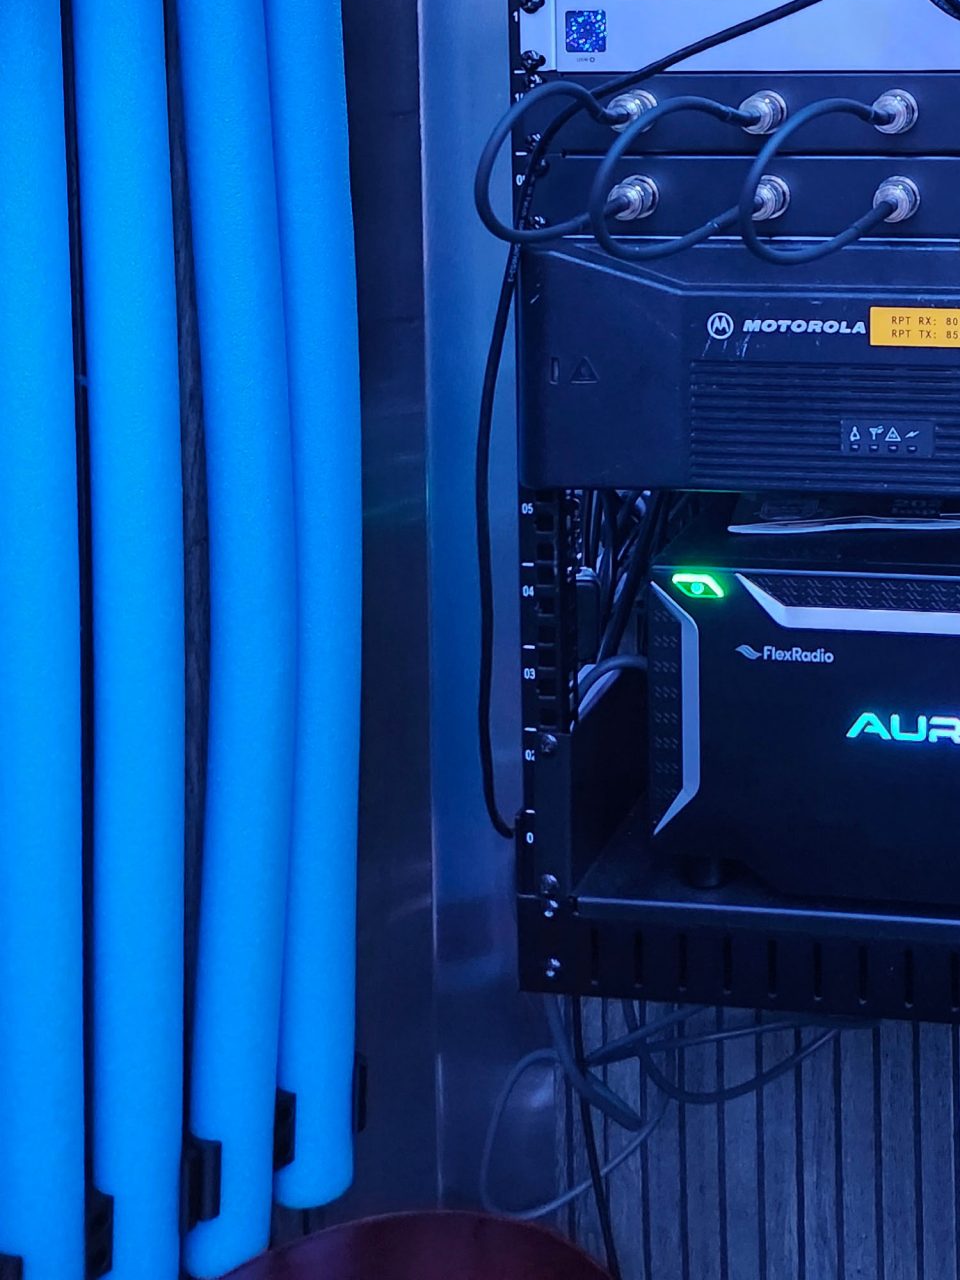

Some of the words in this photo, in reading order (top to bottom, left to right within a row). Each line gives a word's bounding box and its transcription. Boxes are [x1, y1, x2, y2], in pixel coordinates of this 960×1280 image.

[742, 319, 867, 334] MOTOROLA
[891, 316, 910, 326] RPT
[918, 316, 937, 326] RX:
[891, 329, 911, 339] RPT
[919, 330, 937, 339] TX:
[521, 503, 533, 515] 05
[522, 585, 534, 597] 04
[763, 645, 834, 663] FlexRadio
[523, 668, 536, 679] 03
